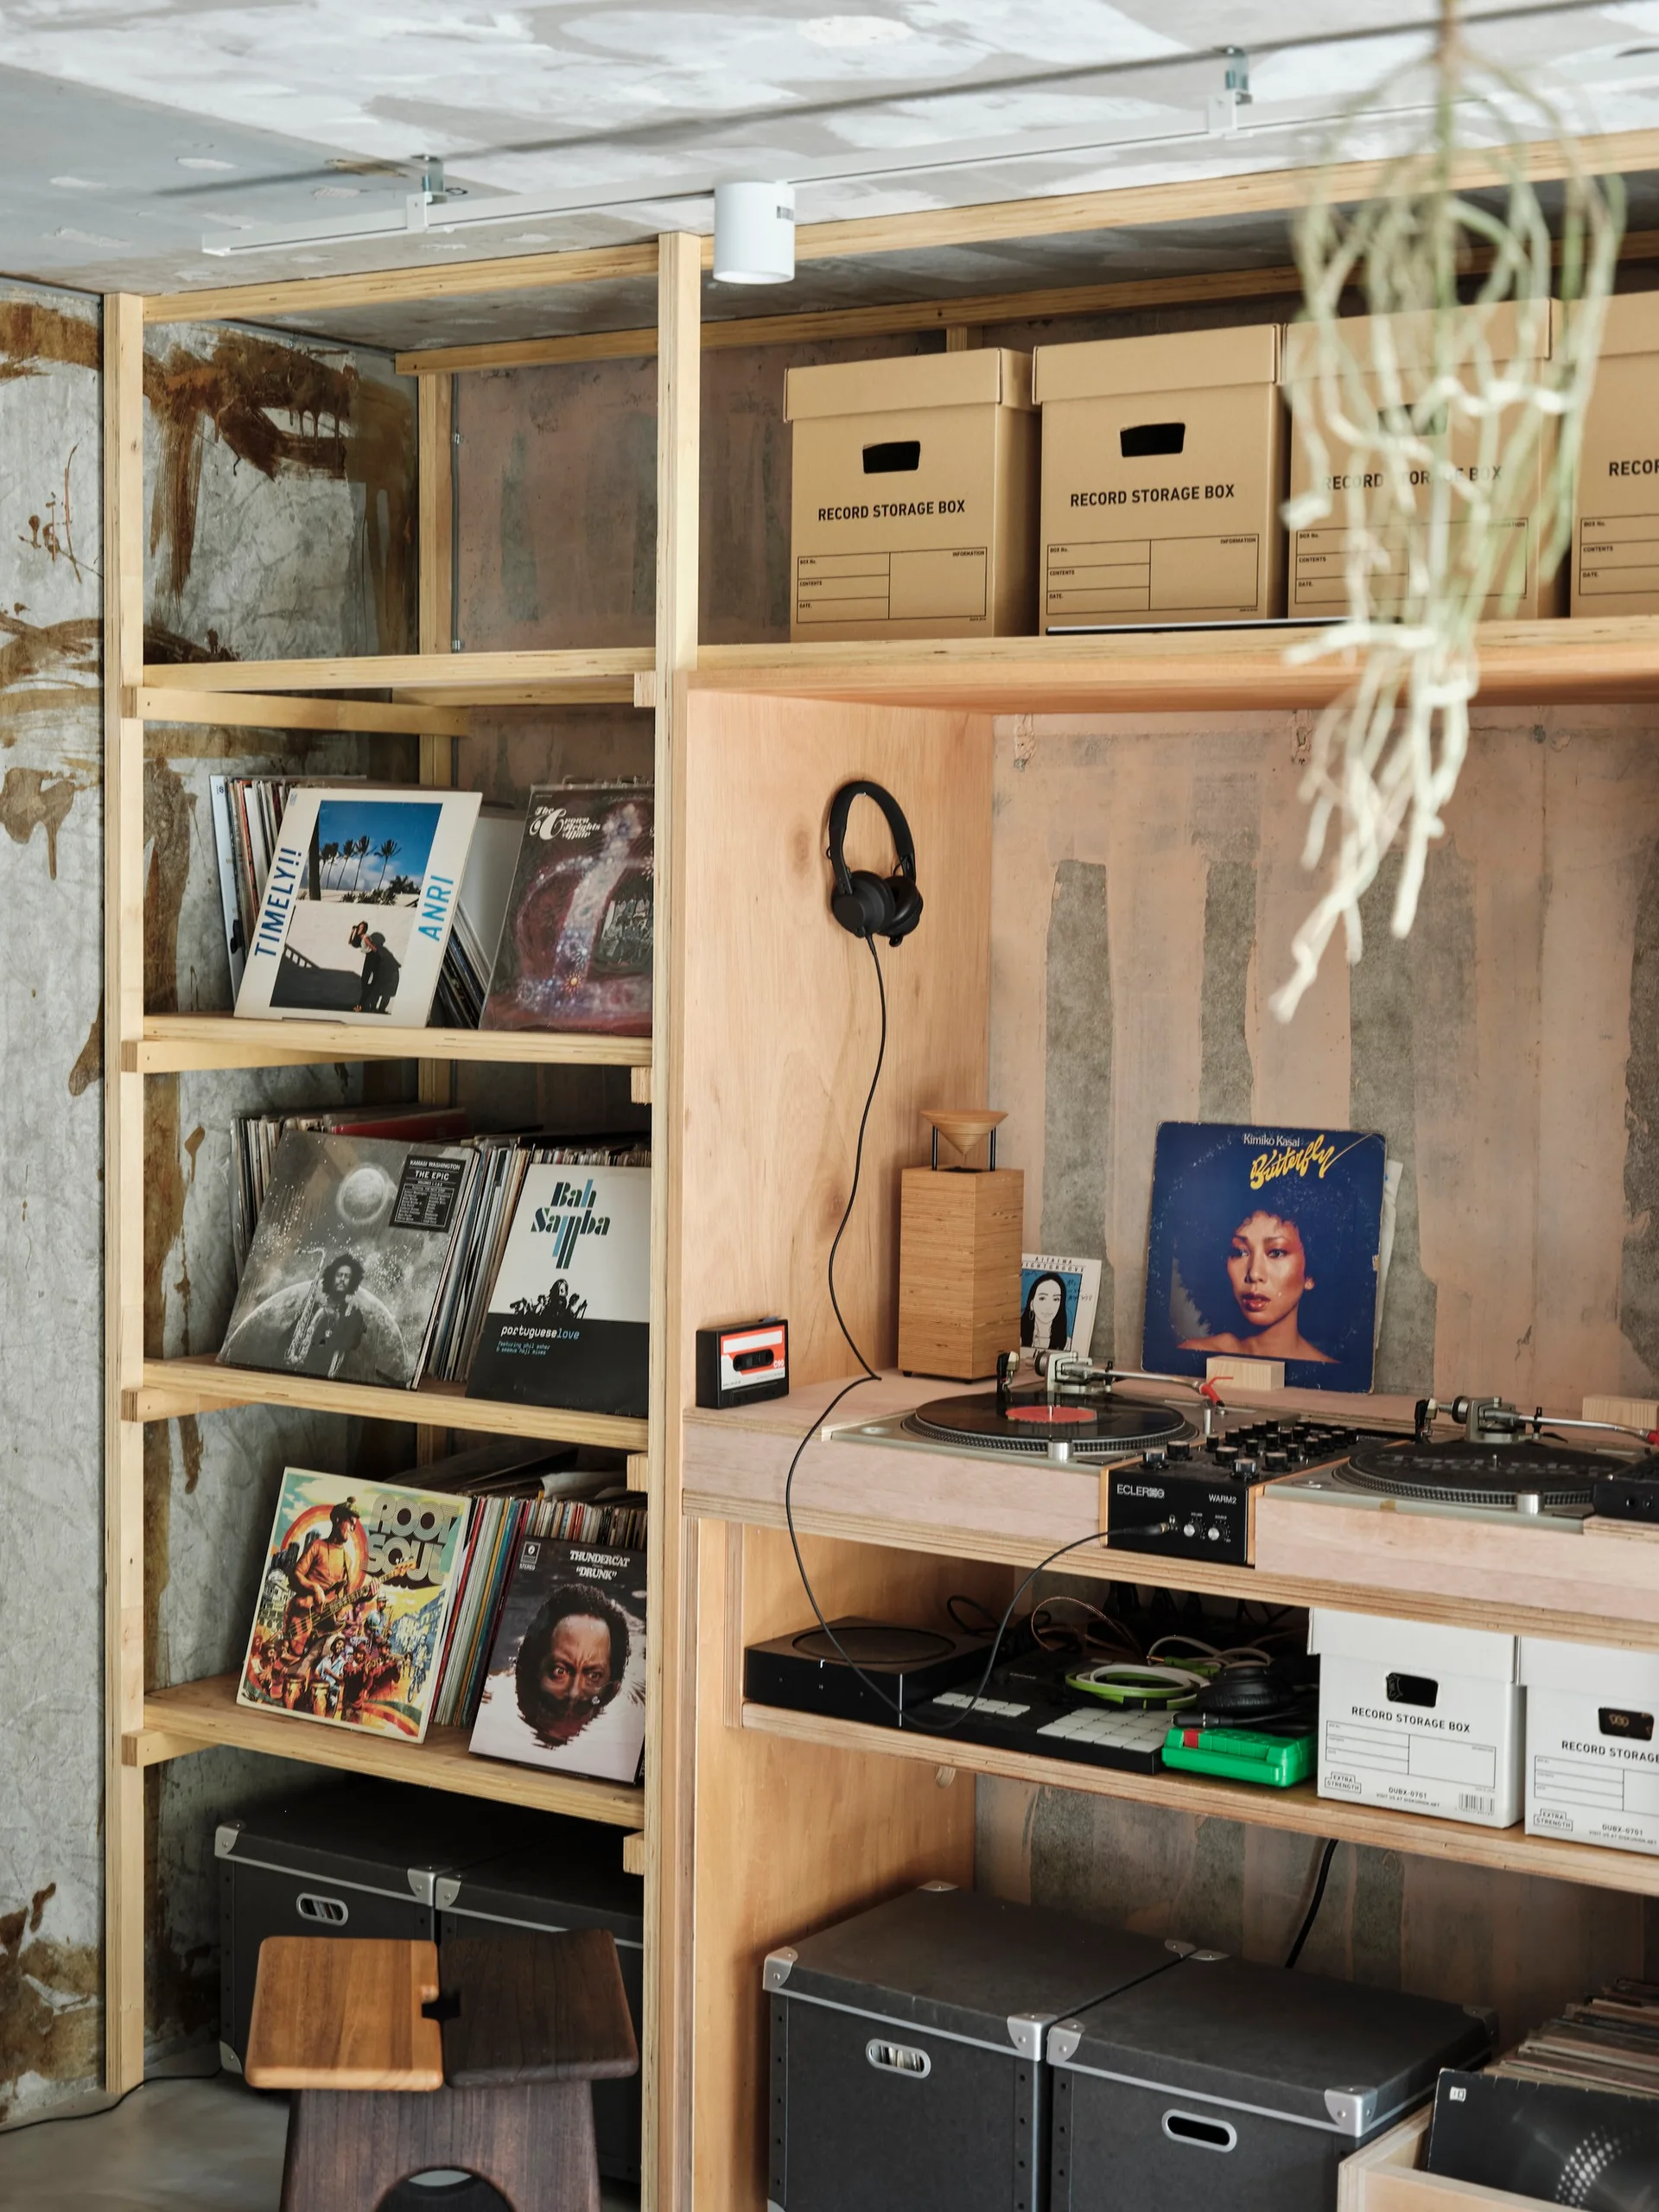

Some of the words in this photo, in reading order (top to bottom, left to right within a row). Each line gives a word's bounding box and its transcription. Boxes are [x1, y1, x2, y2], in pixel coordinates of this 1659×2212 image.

[1070, 491, 1127, 507] RECORD
[1132, 486, 1200, 504] STORAGE
[1205, 484, 1235, 499] BOX
[818, 505, 869, 521] RECORD
[873, 501, 934, 518] STORAGE
[938, 499, 965, 514] BOX
[254, 847, 302, 957] TIMELY!!
[417, 874, 454, 942] ANRI
[1243, 1133, 1275, 1147] Kimiko
[428, 1161, 461, 1170] WASHINGTON
[1249, 1134, 1338, 1190] Butterfly
[415, 1170, 430, 1179] THE
[431, 1172, 449, 1181] EPIC
[550, 1179, 597, 1208] Bah
[531, 1207, 611, 1269] Samba
[1021, 1262, 1084, 1273] IGHTGROOVE
[1116, 1484, 1150, 1497] ECLER
[1209, 1494, 1237, 1504] WARM2
[369, 1493, 460, 1544] ROOT
[569, 1549, 630, 1567] THUNDERCAT
[1351, 1706, 1393, 1721] RECORD
[1395, 1713, 1445, 1730] STORAGE
[1448, 1721, 1471, 1733] BOX
[1561, 1739, 1605, 1756] RECORD
[1326, 1780, 1359, 1791] STRENGTH
[1333, 1774, 1353, 1783] EXTRA
[1536, 1817, 1571, 1828] STRENGTH
[1542, 1811, 1564, 1820] EXTRA
